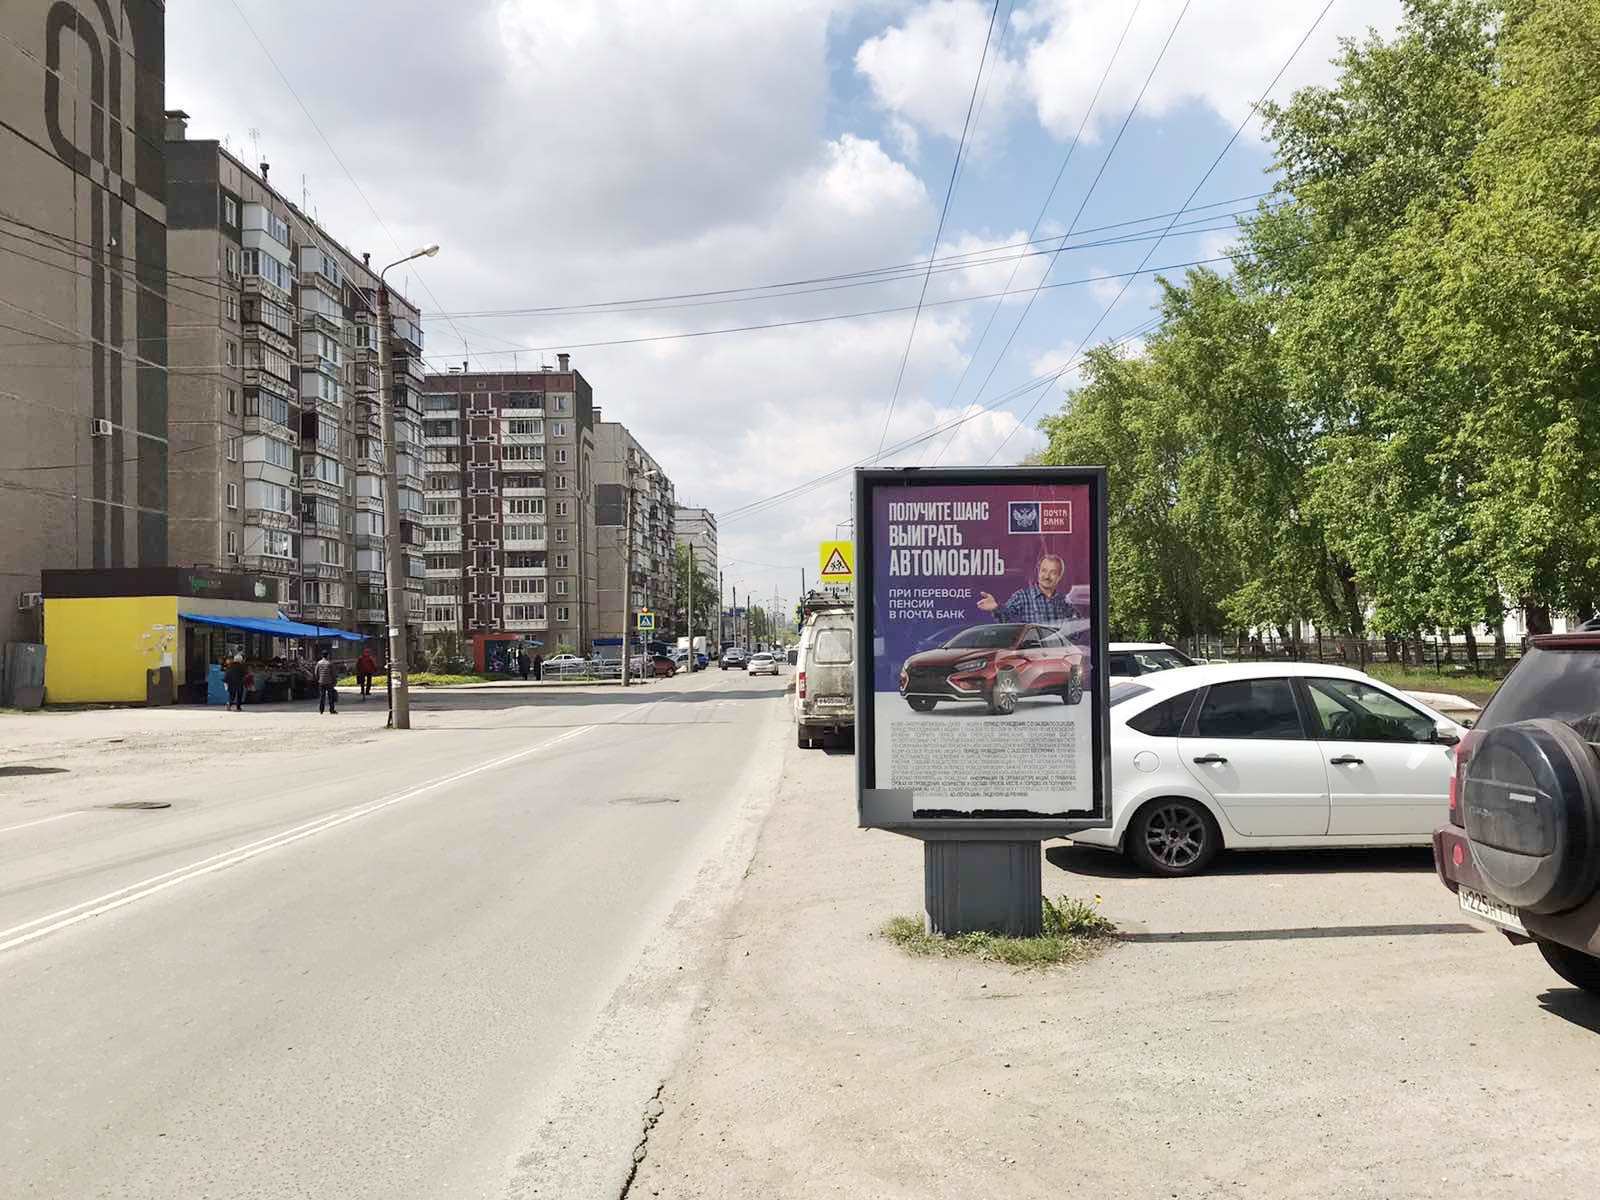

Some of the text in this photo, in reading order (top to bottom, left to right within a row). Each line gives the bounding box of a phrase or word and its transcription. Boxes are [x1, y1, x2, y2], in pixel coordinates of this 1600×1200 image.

[889, 502, 989, 521] ПОЛУЧИТЕ ШАНС
[1043, 509, 1068, 517] ПОЧТА
[1043, 518, 1065, 526] БАНК
[889, 525, 962, 546] ВЫИГРАТЬ
[889, 549, 1005, 577] АВТОМОБИЛЬ
[889, 588, 972, 598] ПРИ ПЕРЕВОДЕ
[889, 599, 934, 609] ПЕНСИИ
[889, 610, 965, 619] В ПОЧТА БАНК
